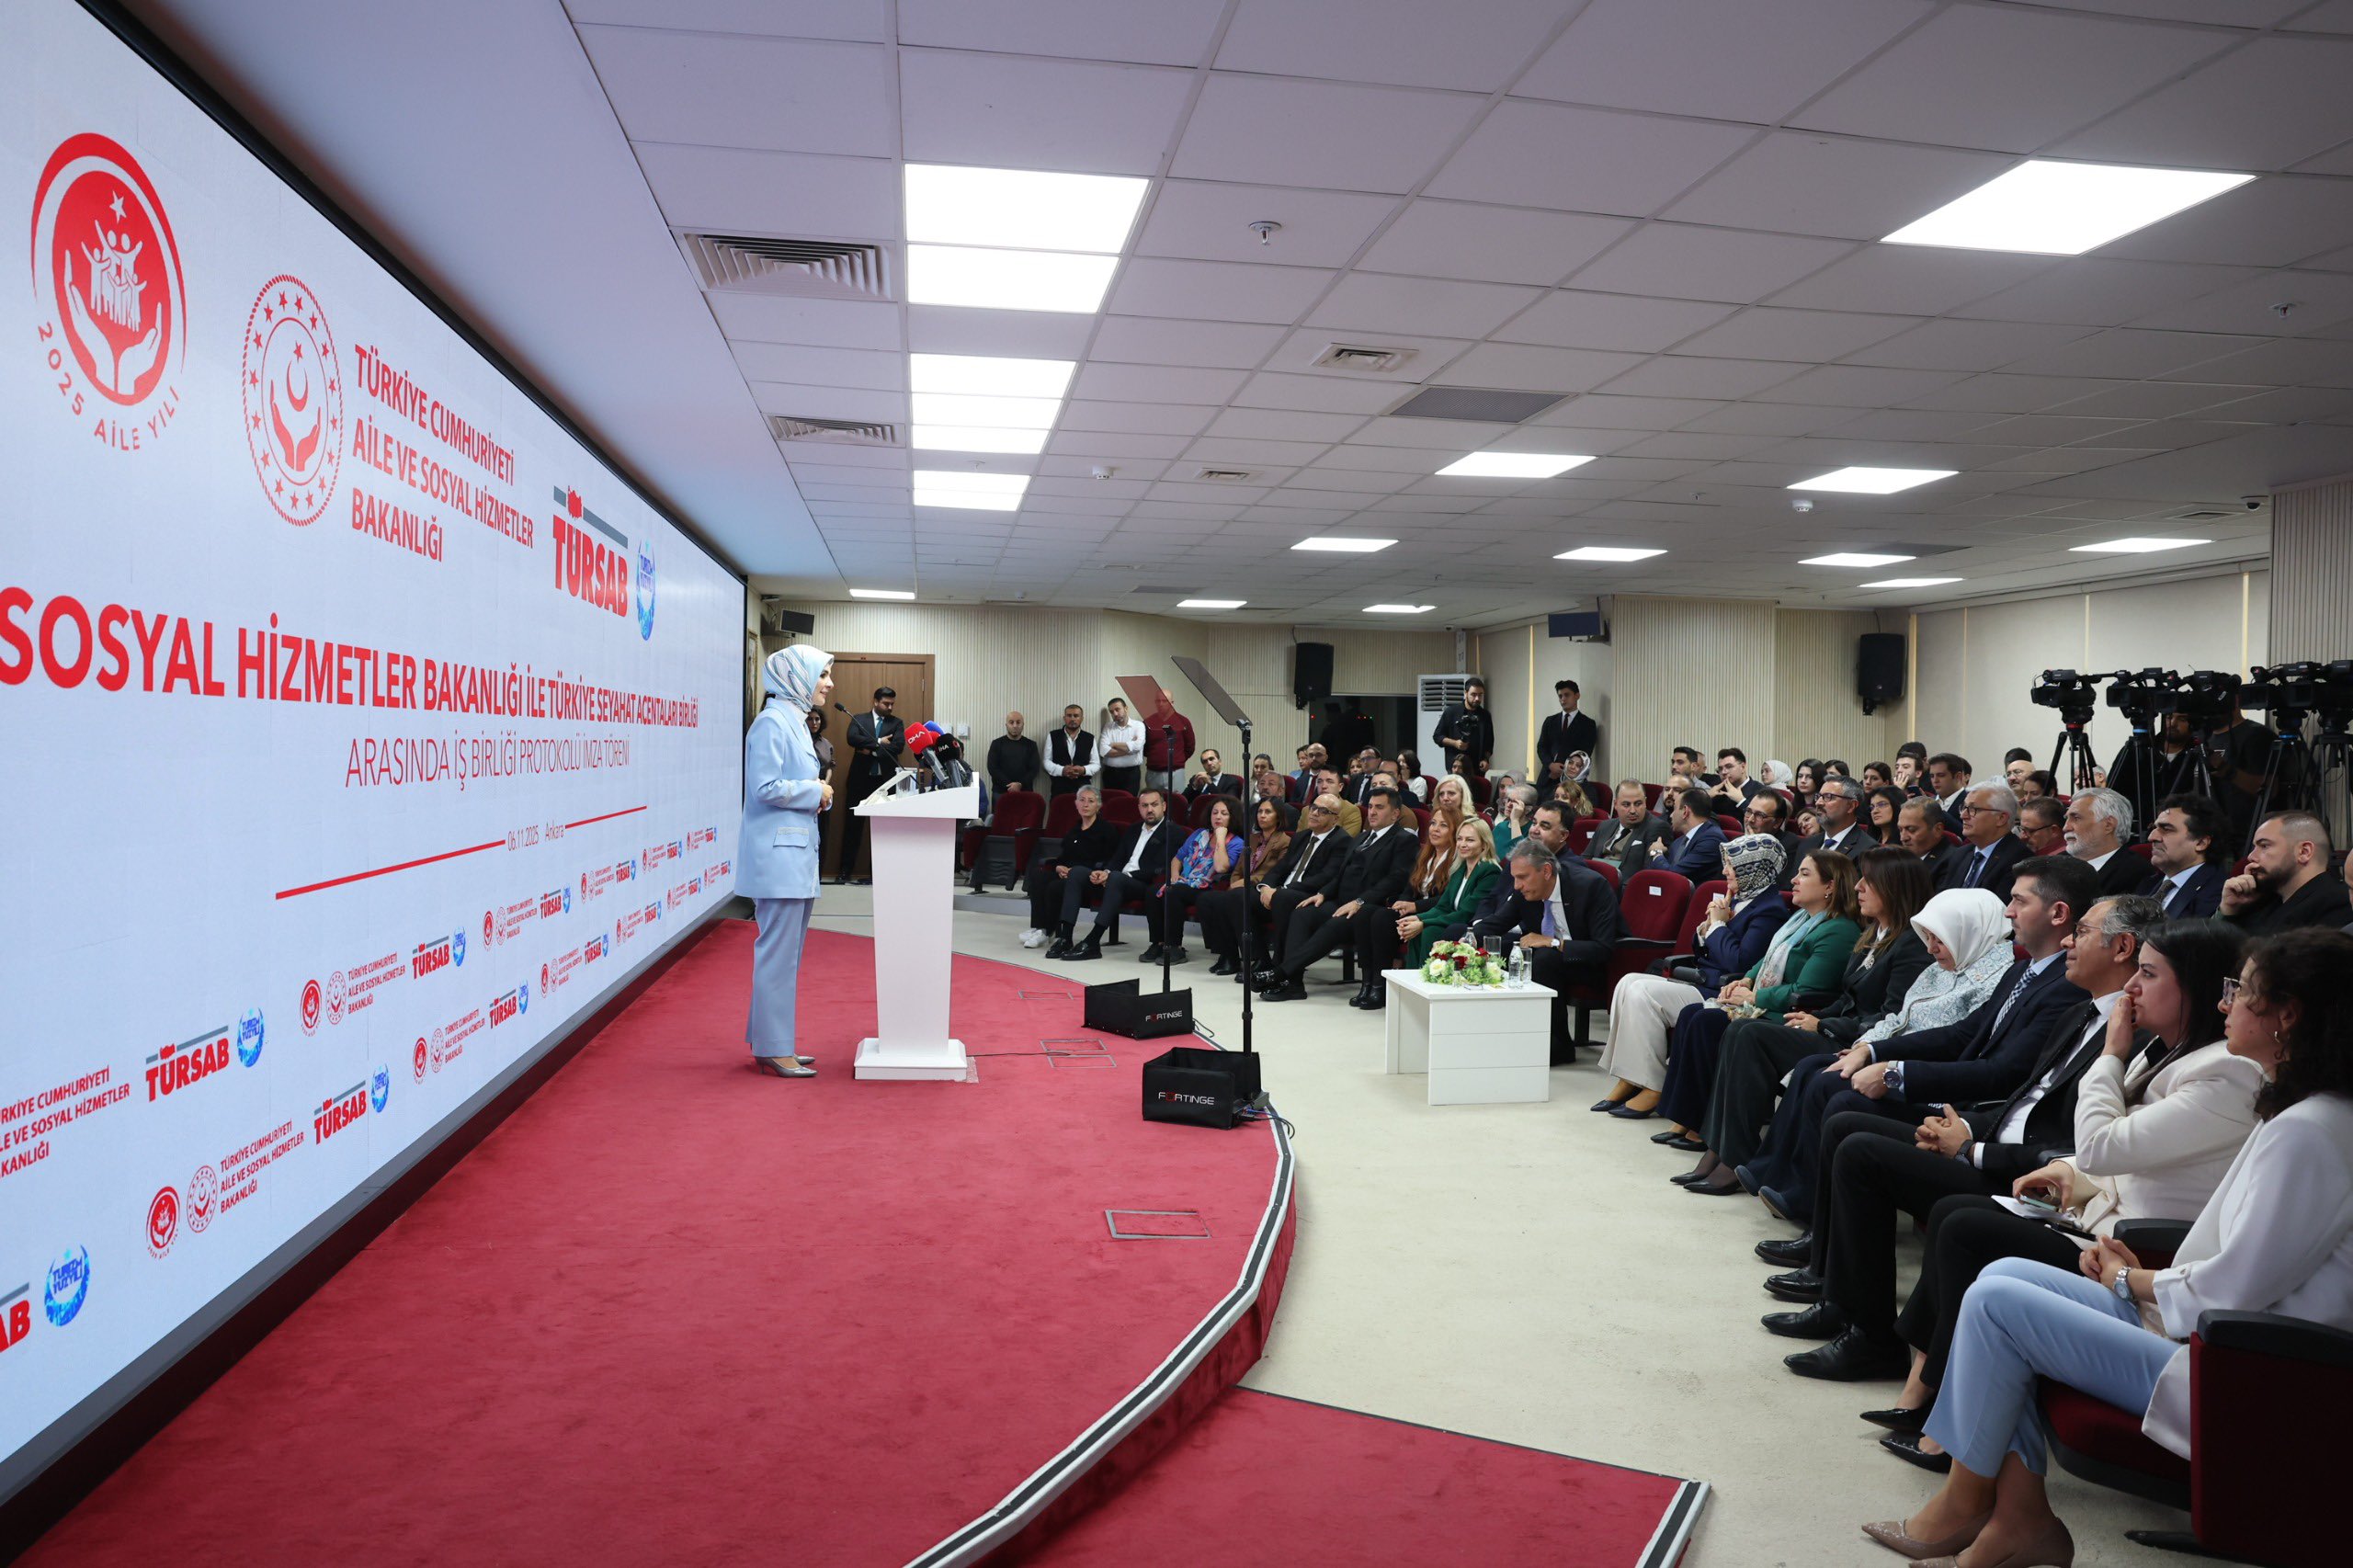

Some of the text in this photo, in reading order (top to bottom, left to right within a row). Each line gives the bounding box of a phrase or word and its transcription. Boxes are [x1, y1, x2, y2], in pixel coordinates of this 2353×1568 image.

[38, 322, 179, 451] 2025 AİLE YILI
[355, 344, 514, 486] TÜRKİYE CUMHURİYETİ
[352, 415, 533, 549] AİLE VE SOSYAL HİZMETLER
[352, 487, 443, 562] BAKANLIĞI
[0, 586, 699, 728] SOSYAL HİZMETLER BAKANLIĞI İLE TÜRKİYE SEYAHAT ACENTALARI BİRLİĞİ
[346, 729, 630, 791] ARASINDA İŞ BİRLİĞİ PROTOKOLÜ İMZA TÖRENİ
[907, 731, 926, 744] DHA
[507, 821, 564, 852] 06.11.2025 Ankara
[1145, 1010, 1183, 1022] FORTINGE
[13, 1125, 28, 1145] VE
[31, 1107, 74, 1138] SOSYAL
[74, 1083, 131, 1119] HİZMETLER
[38, 1064, 109, 1109] CUMHURİYETİ
[1158, 1092, 1215, 1106] FORTINGE
[0, 1141, 50, 1178] KANLIĞI
[221, 1118, 292, 1174] TÜRKİYE CUMHURİYETİ
[221, 1131, 304, 1194] AİLE VE SOSYAL HİZMETLER
[221, 1178, 257, 1213] BAKANLIĞI
